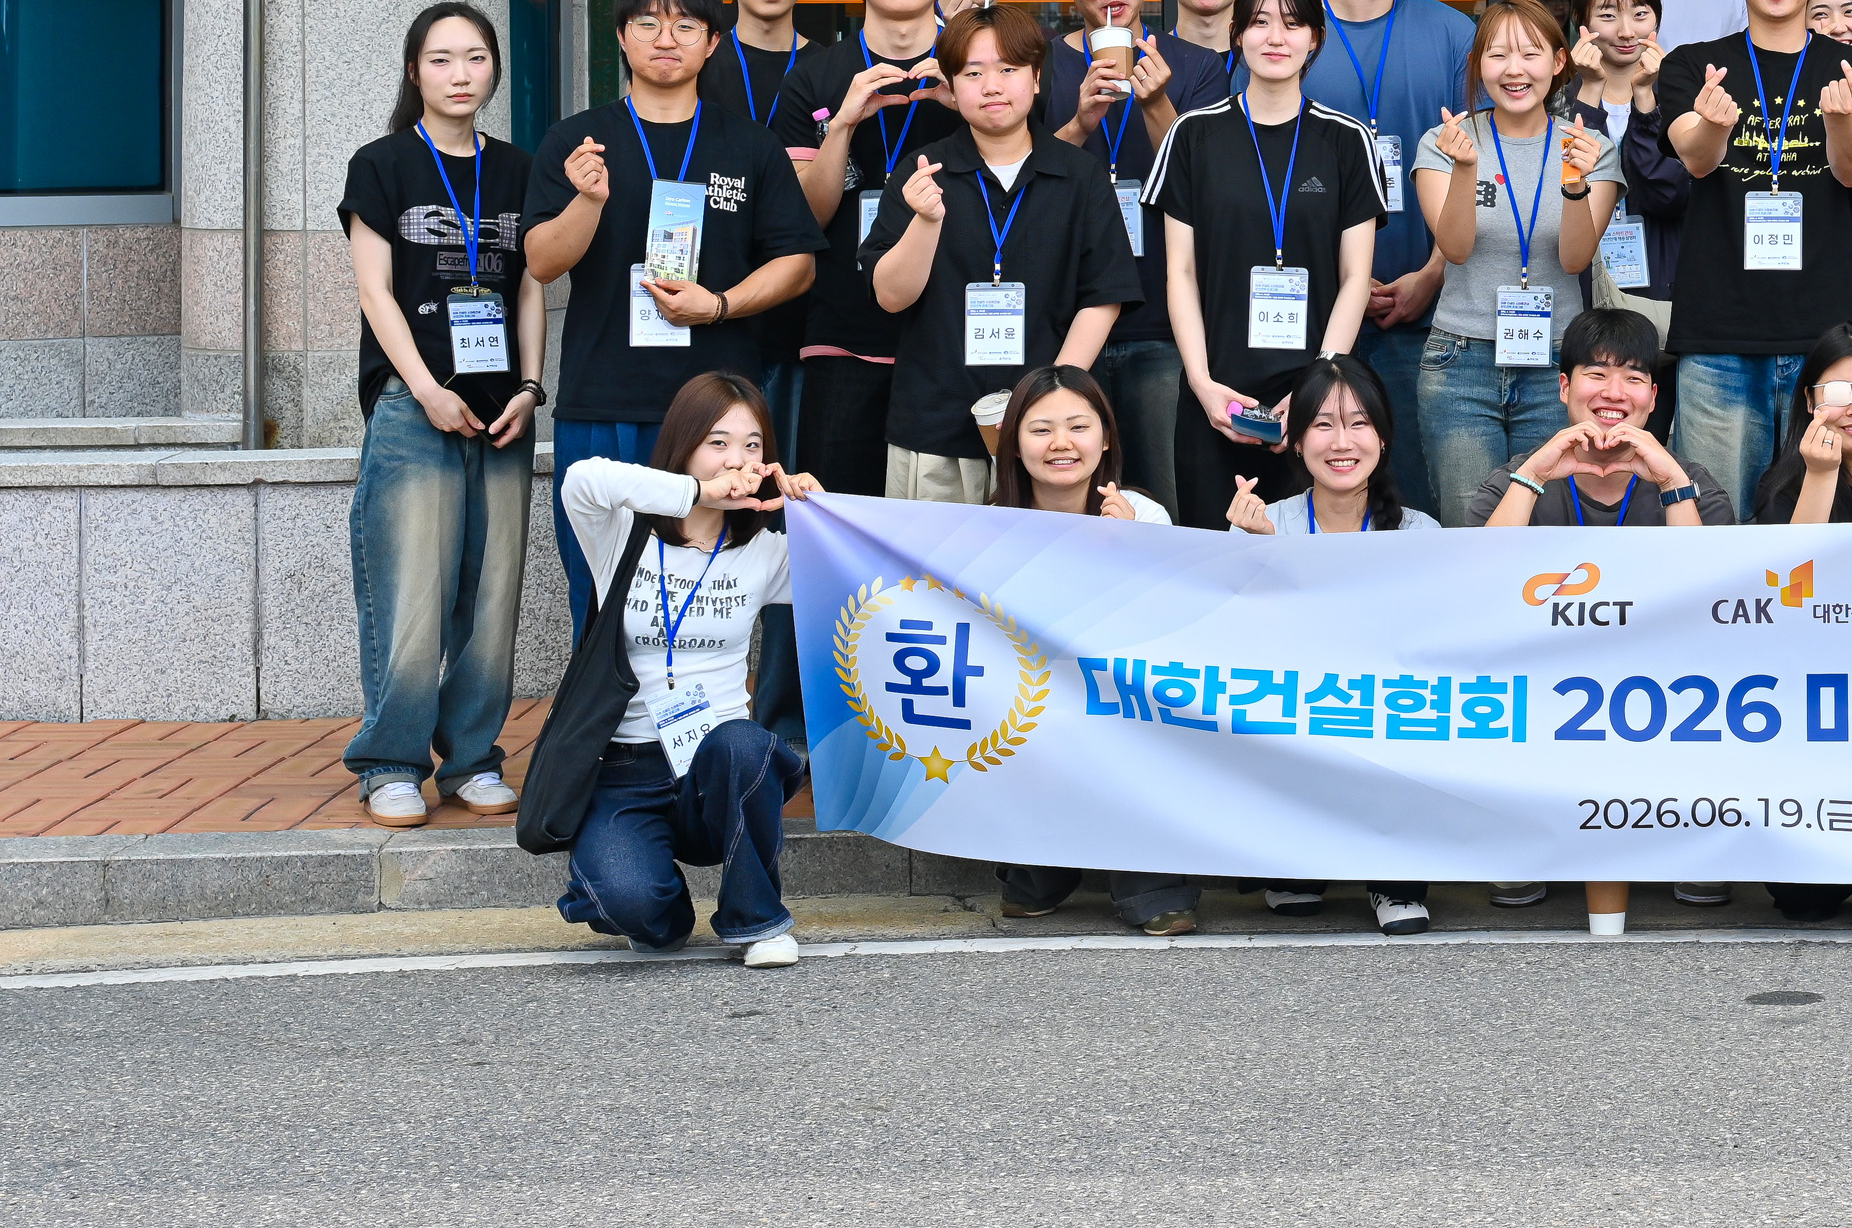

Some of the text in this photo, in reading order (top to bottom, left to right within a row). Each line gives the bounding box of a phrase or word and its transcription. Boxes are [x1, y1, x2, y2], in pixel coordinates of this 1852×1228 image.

[709, 172, 746, 190] Royal
[1297, 185, 1327, 193] adidas
[709, 196, 738, 213] Club
[438, 252, 484, 268] Escapefrm.
[636, 566, 738, 591] NDESTOO THAT
[655, 589, 679, 603] TE
[655, 602, 705, 618] PAED
[713, 606, 732, 620] ME
[1551, 600, 1634, 627] KICT
[1711, 598, 1775, 625] CAK
[884, 618, 985, 731] 환
[1077, 656, 1529, 744] 대한건설협회
[1553, 673, 1781, 744] 2026
